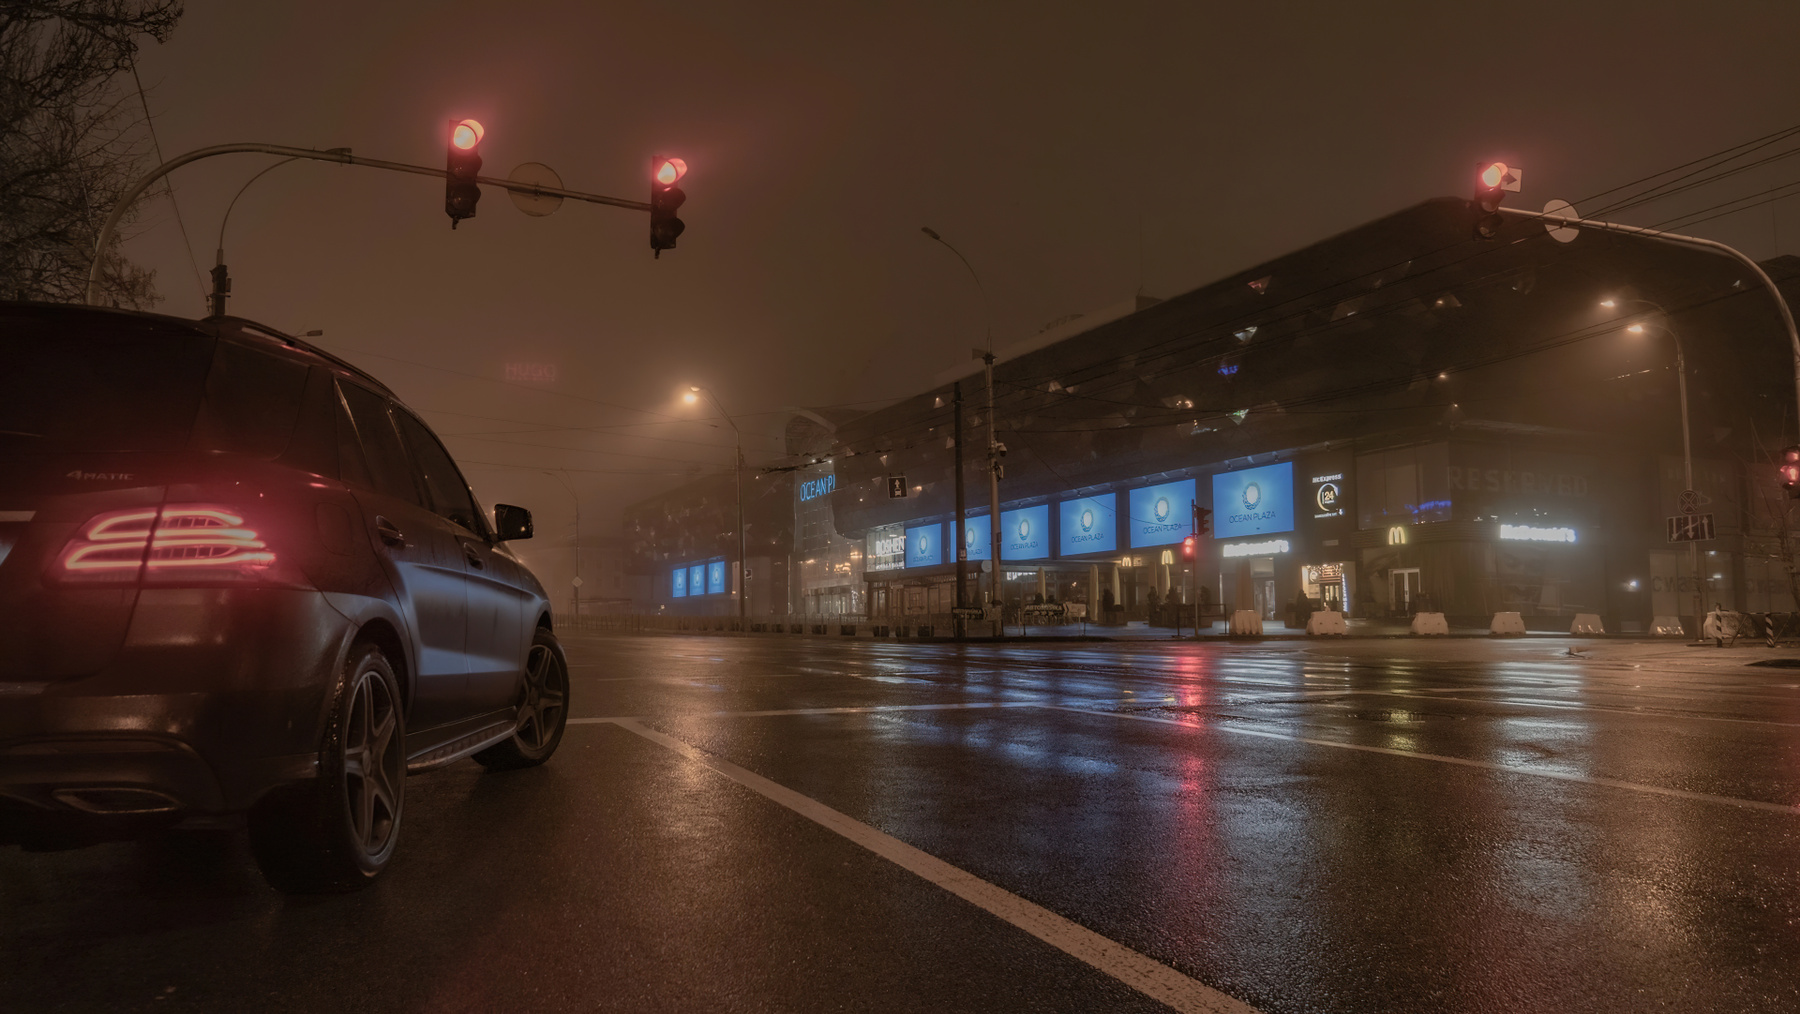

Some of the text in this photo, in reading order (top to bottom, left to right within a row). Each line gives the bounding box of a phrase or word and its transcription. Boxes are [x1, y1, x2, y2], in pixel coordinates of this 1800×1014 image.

[66, 470, 135, 481] 4MATIC
[1450, 466, 1589, 497] RESERVED
[800, 477, 827, 502] OCEAN
[1324, 490, 1334, 501] 24
[1229, 511, 1276, 524] OCEAN PLAZA
[1143, 523, 1182, 535] OCEAN PLAZA
[1071, 533, 1104, 543] OCEAN PLAZA
[876, 536, 905, 555] ROSHEN
